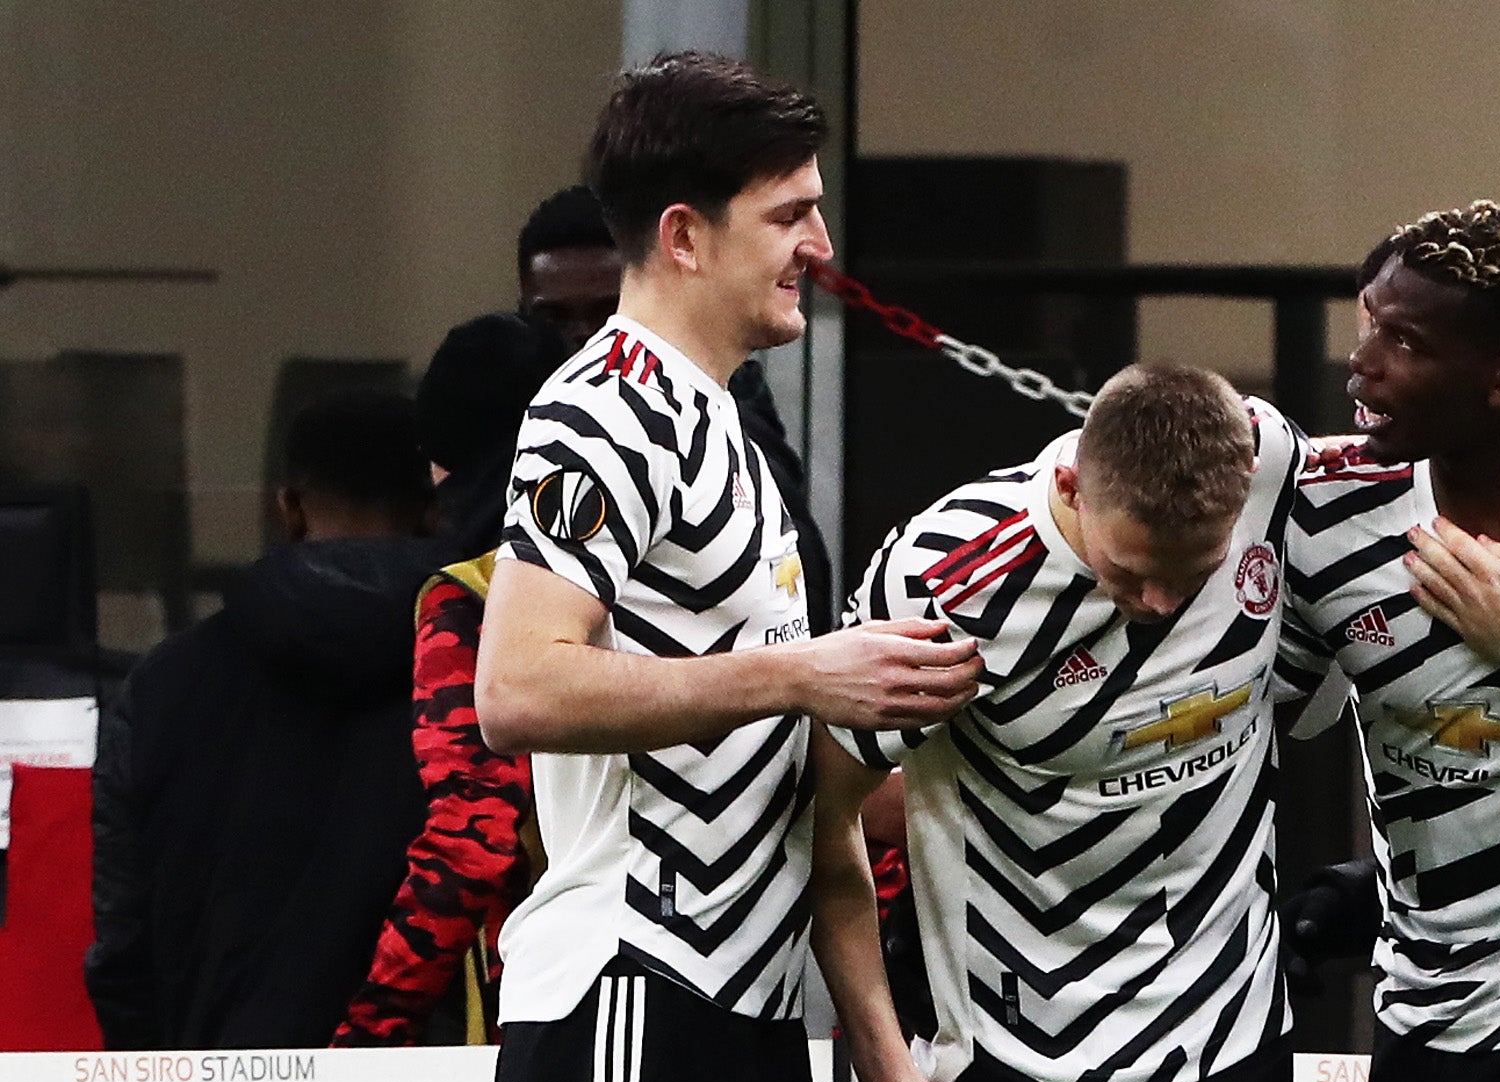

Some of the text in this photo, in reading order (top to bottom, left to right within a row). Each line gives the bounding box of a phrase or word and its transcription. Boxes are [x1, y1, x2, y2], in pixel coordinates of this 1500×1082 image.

[764, 616, 810, 646] CHEVR
[1346, 626, 1396, 648] adidas
[1054, 665, 1109, 690] adidas
[1099, 711, 1261, 798] CHEVROLET
[135, 1056, 194, 1082] SIRO
[201, 1055, 317, 1082] STADIUM
